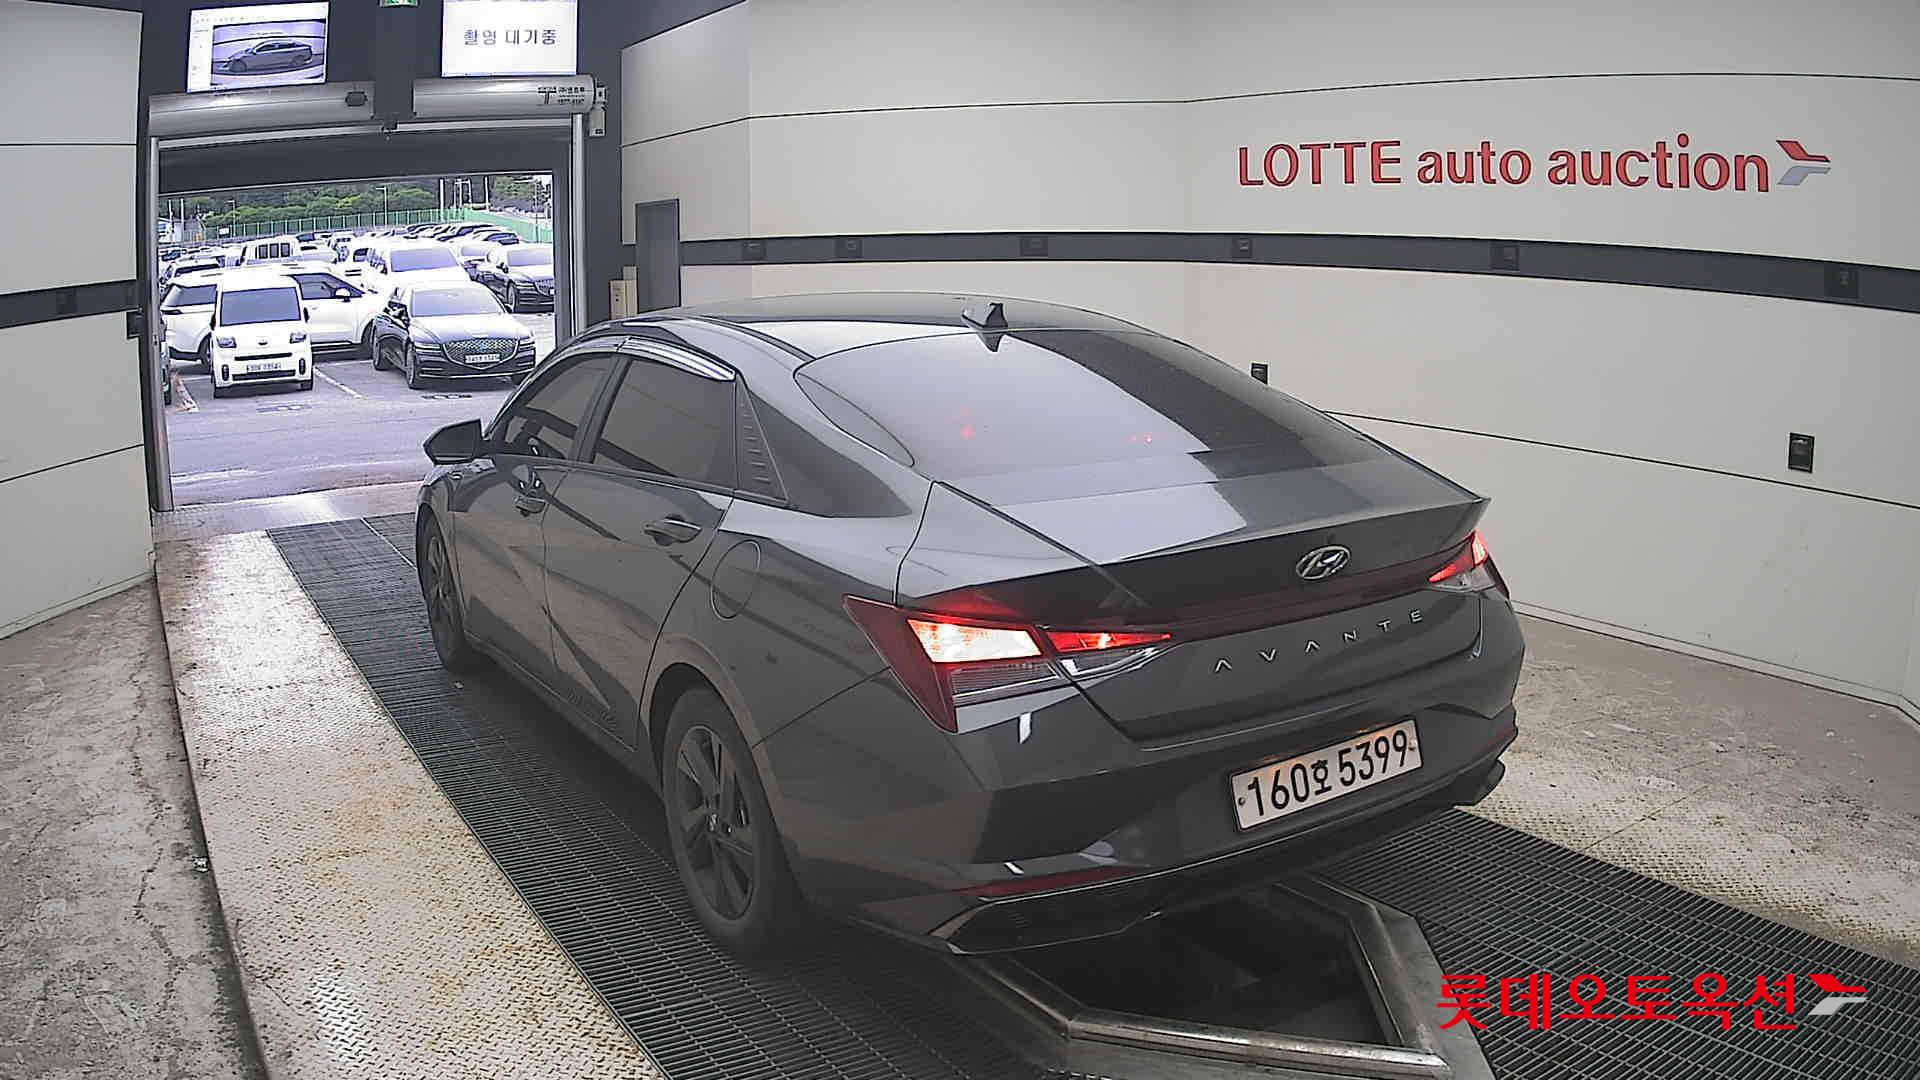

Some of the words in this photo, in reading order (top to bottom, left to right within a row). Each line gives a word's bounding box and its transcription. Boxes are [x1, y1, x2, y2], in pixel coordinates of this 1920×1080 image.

[505, 29, 557, 46] 대기중
[1239, 140, 1401, 187] LOTTE
[1417, 141, 1532, 185] auto
[1547, 133, 1769, 193] auction
[1214, 609, 1423, 673] AVANTE
